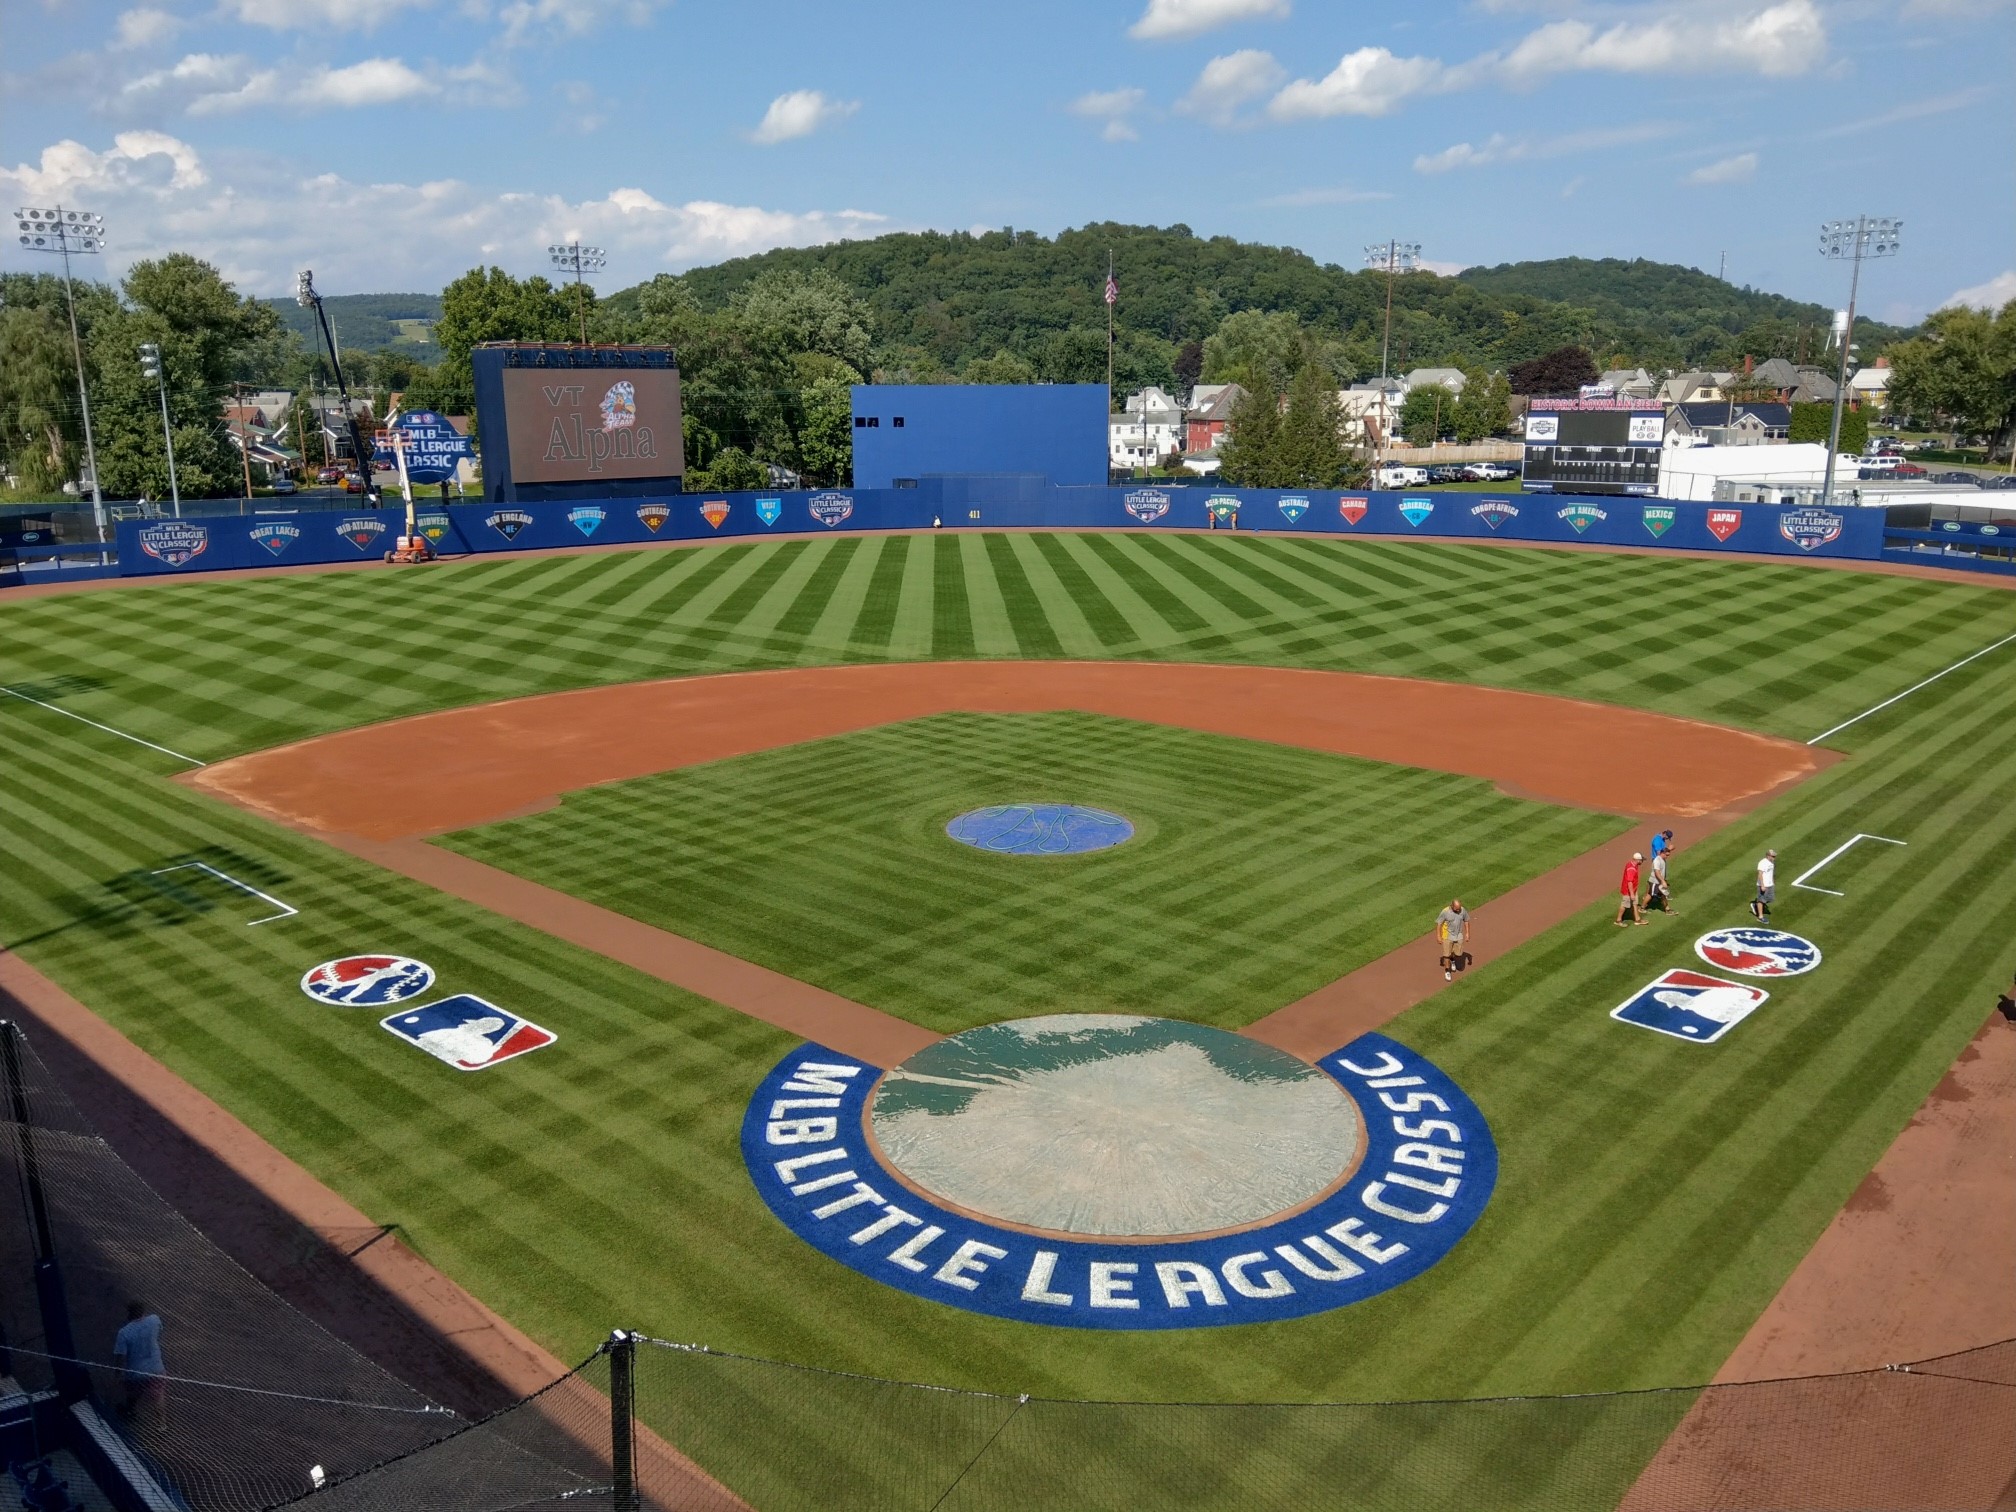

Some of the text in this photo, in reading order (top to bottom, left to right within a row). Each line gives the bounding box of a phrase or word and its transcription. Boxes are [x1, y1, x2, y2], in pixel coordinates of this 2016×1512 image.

[542, 385, 584, 406] VT
[1531, 399, 1663, 411] HISTORIC BOWMAN FIELD
[410, 429, 436, 439] MLB
[1646, 425, 1660, 433] BALL
[421, 440, 466, 452] LEAGUE
[543, 412, 657, 472] Alpha
[1146, 496, 1168, 504] LEAGUE
[1278, 499, 1310, 508] AUSTRALIA
[636, 506, 671, 518] SOUTHEAST
[699, 503, 731, 515] SOUTHWEST
[1398, 501, 1435, 512] CARIBBEAN
[567, 509, 607, 522] NORTHWEST
[1557, 506, 1608, 521] LATIN AMERICA
[1645, 510, 1674, 520] MEXICO
[1712, 513, 1737, 523] JAPAN
[417, 517, 450, 527] MIDWEST
[485, 513, 534, 527] NEW ENGLAND
[1783, 516, 1840, 527] LITTLE LEAGUE
[249, 526, 300, 540] GREAT LAKES
[335, 521, 387, 536] MID-ATLANTIC
[1720, 525, 1726, 534] J
[1795, 525, 1826, 535] CLASSIC
[142, 530, 205, 541] LITTLE LEAGUE
[158, 539, 191, 549] CLASSIC
[766, 1051, 1466, 1310] MLB LITTLE LEAGUE CLASSIC
